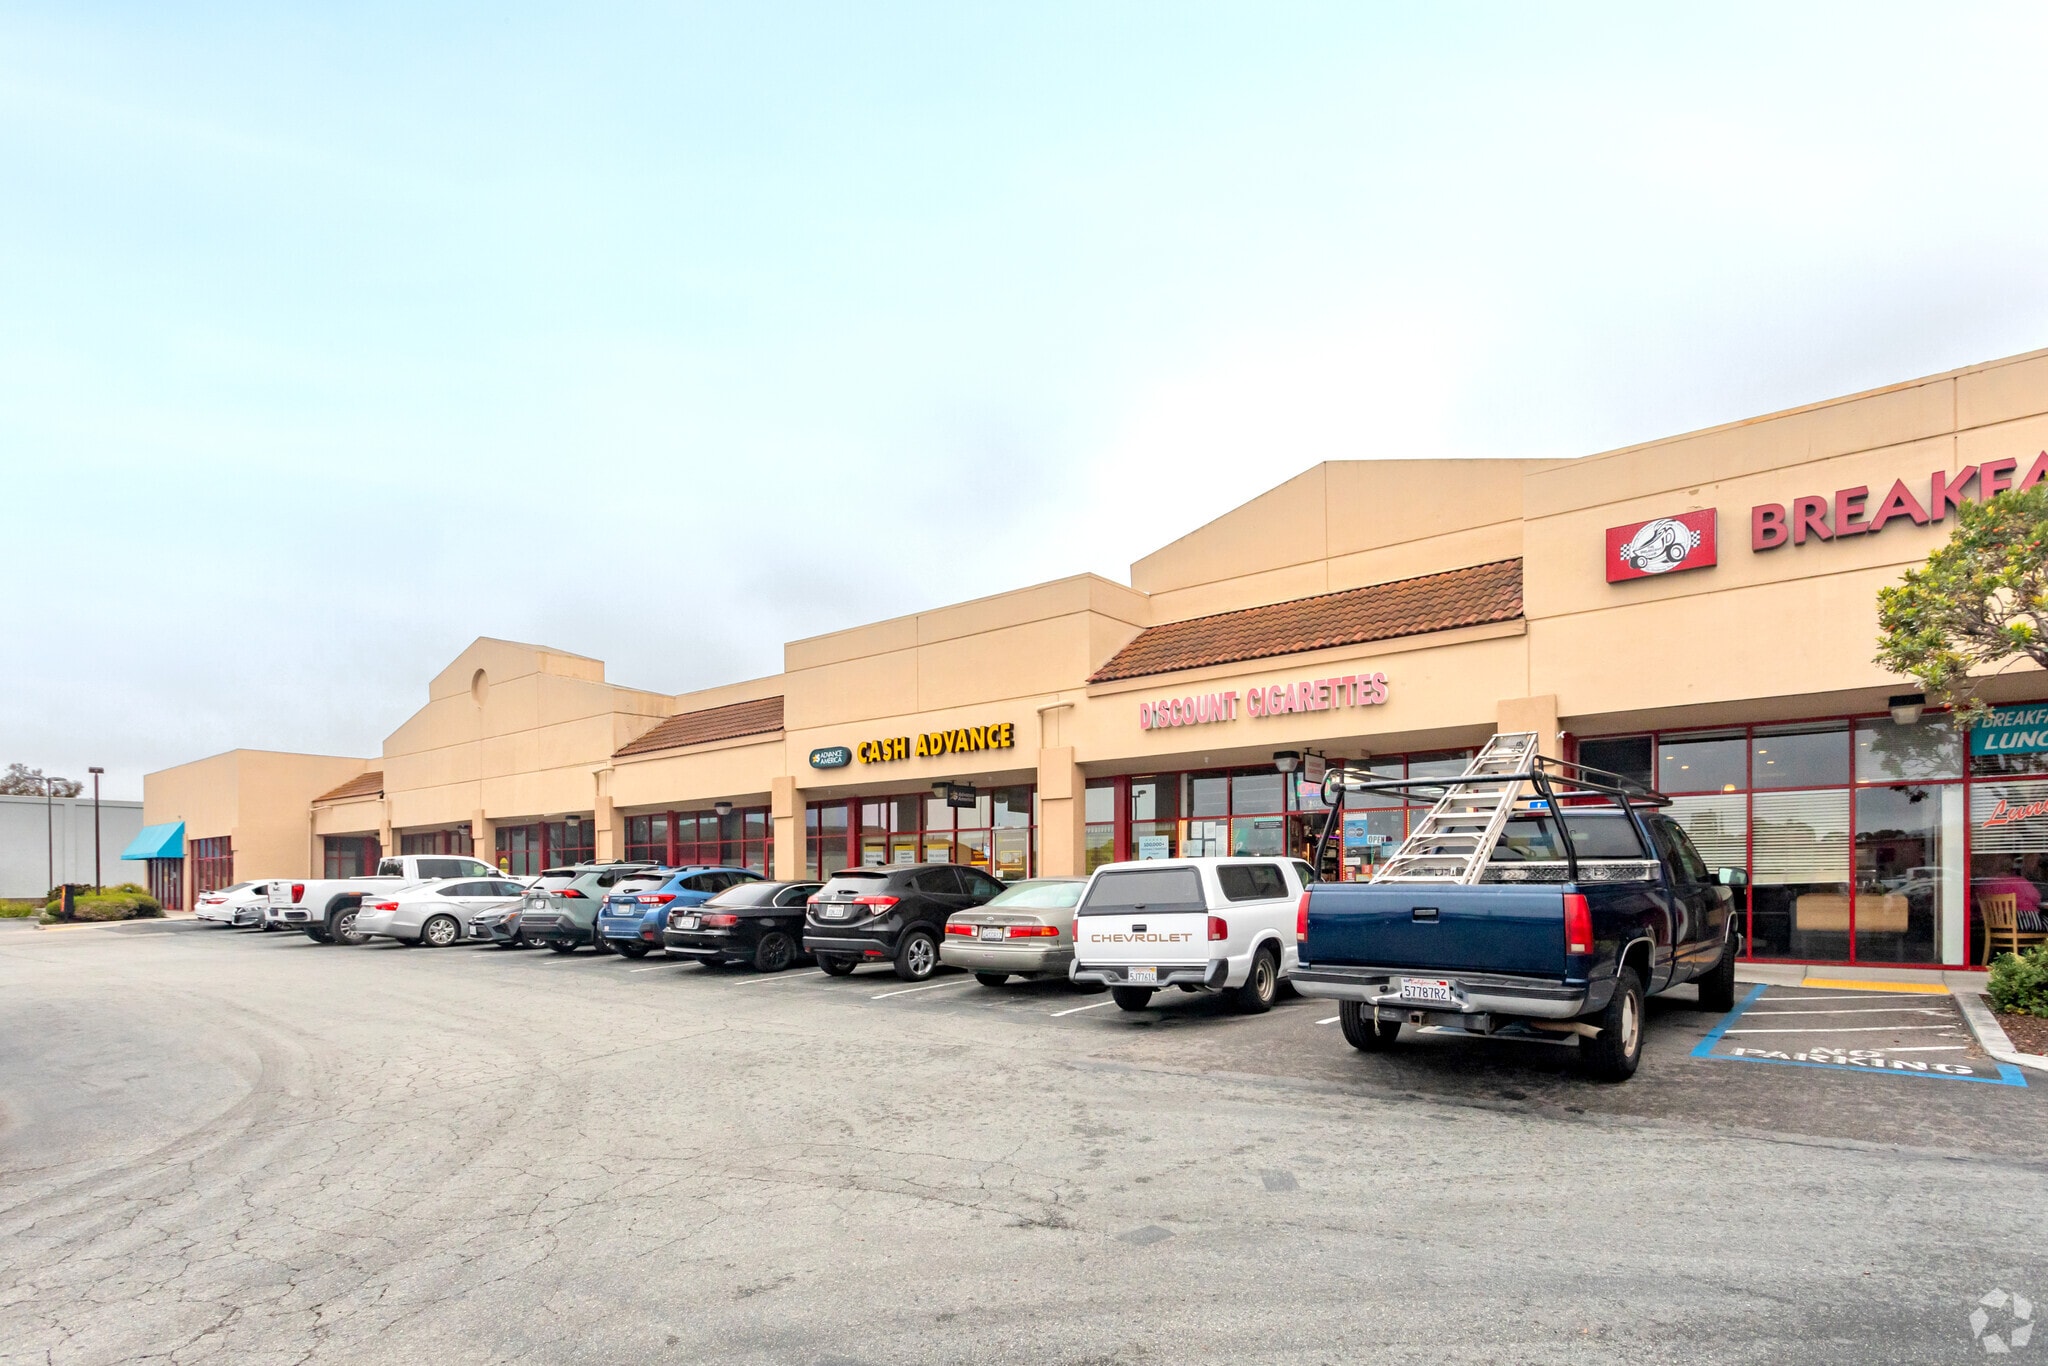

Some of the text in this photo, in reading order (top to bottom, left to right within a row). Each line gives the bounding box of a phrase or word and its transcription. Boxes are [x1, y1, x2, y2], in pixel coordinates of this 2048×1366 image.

[1140, 672, 1388, 730] DISCOUNT CIGARETTES
[857, 723, 1013, 764] CASH ADVANCE
[820, 749, 843, 758] ADVANCE
[820, 756, 843, 765] AMERICA
[1368, 835, 1385, 844] OPEN
[1091, 933, 1192, 942] CHEVROLET
[1404, 985, 1446, 1000] 57787R2
[1809, 1047, 1885, 1058] NO
[1730, 1047, 1973, 1074] PARKING
